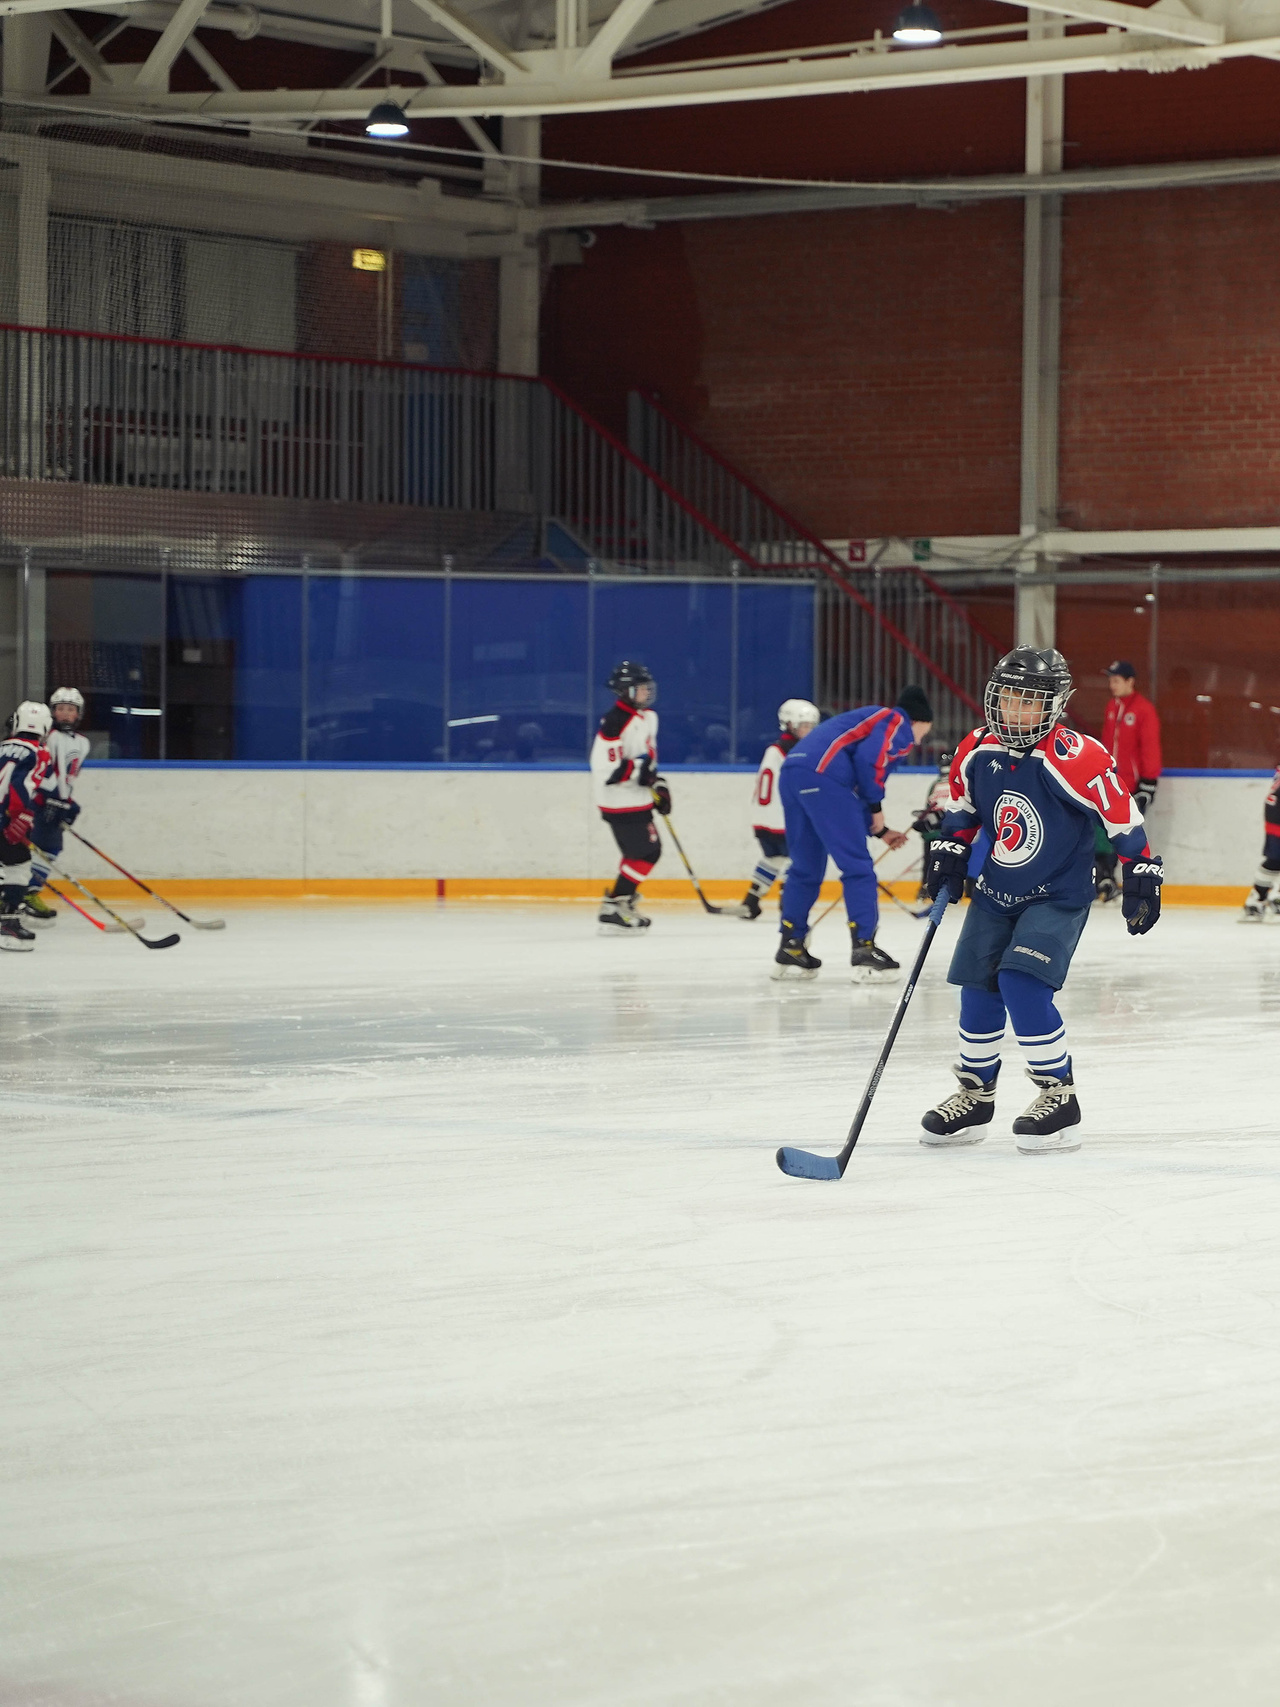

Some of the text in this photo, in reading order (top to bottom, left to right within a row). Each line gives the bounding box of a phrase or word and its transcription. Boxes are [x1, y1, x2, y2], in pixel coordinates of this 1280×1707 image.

[1016, 801, 1037, 851] CLUB VIKHR
[930, 840, 966, 854] OKS
[1132, 863, 1165, 877] ORO
